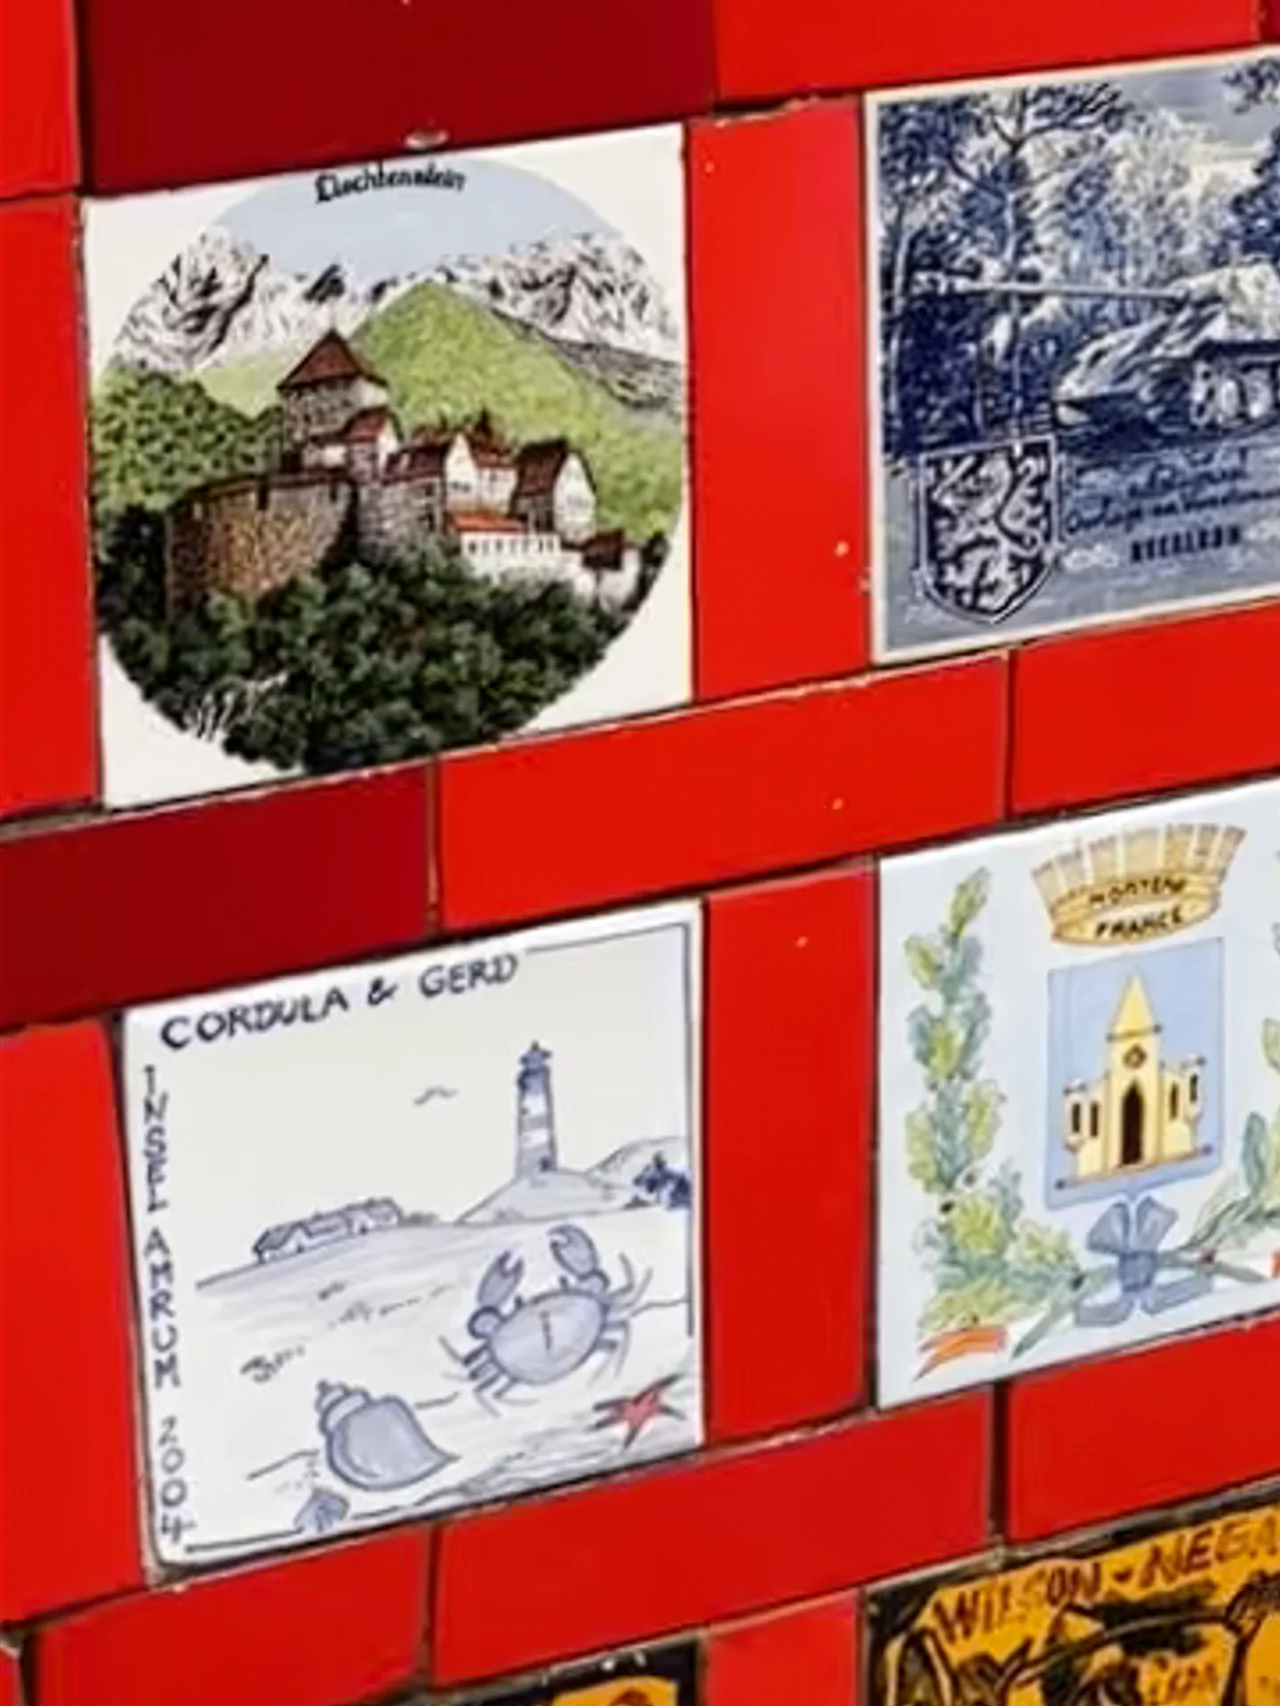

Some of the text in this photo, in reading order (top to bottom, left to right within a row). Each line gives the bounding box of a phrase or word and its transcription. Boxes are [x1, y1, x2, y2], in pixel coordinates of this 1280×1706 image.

[159, 953, 519, 1050] CORDULA & GERD
[143, 1064, 168, 1212] INSEL
[158, 1416, 198, 1544] 2004
